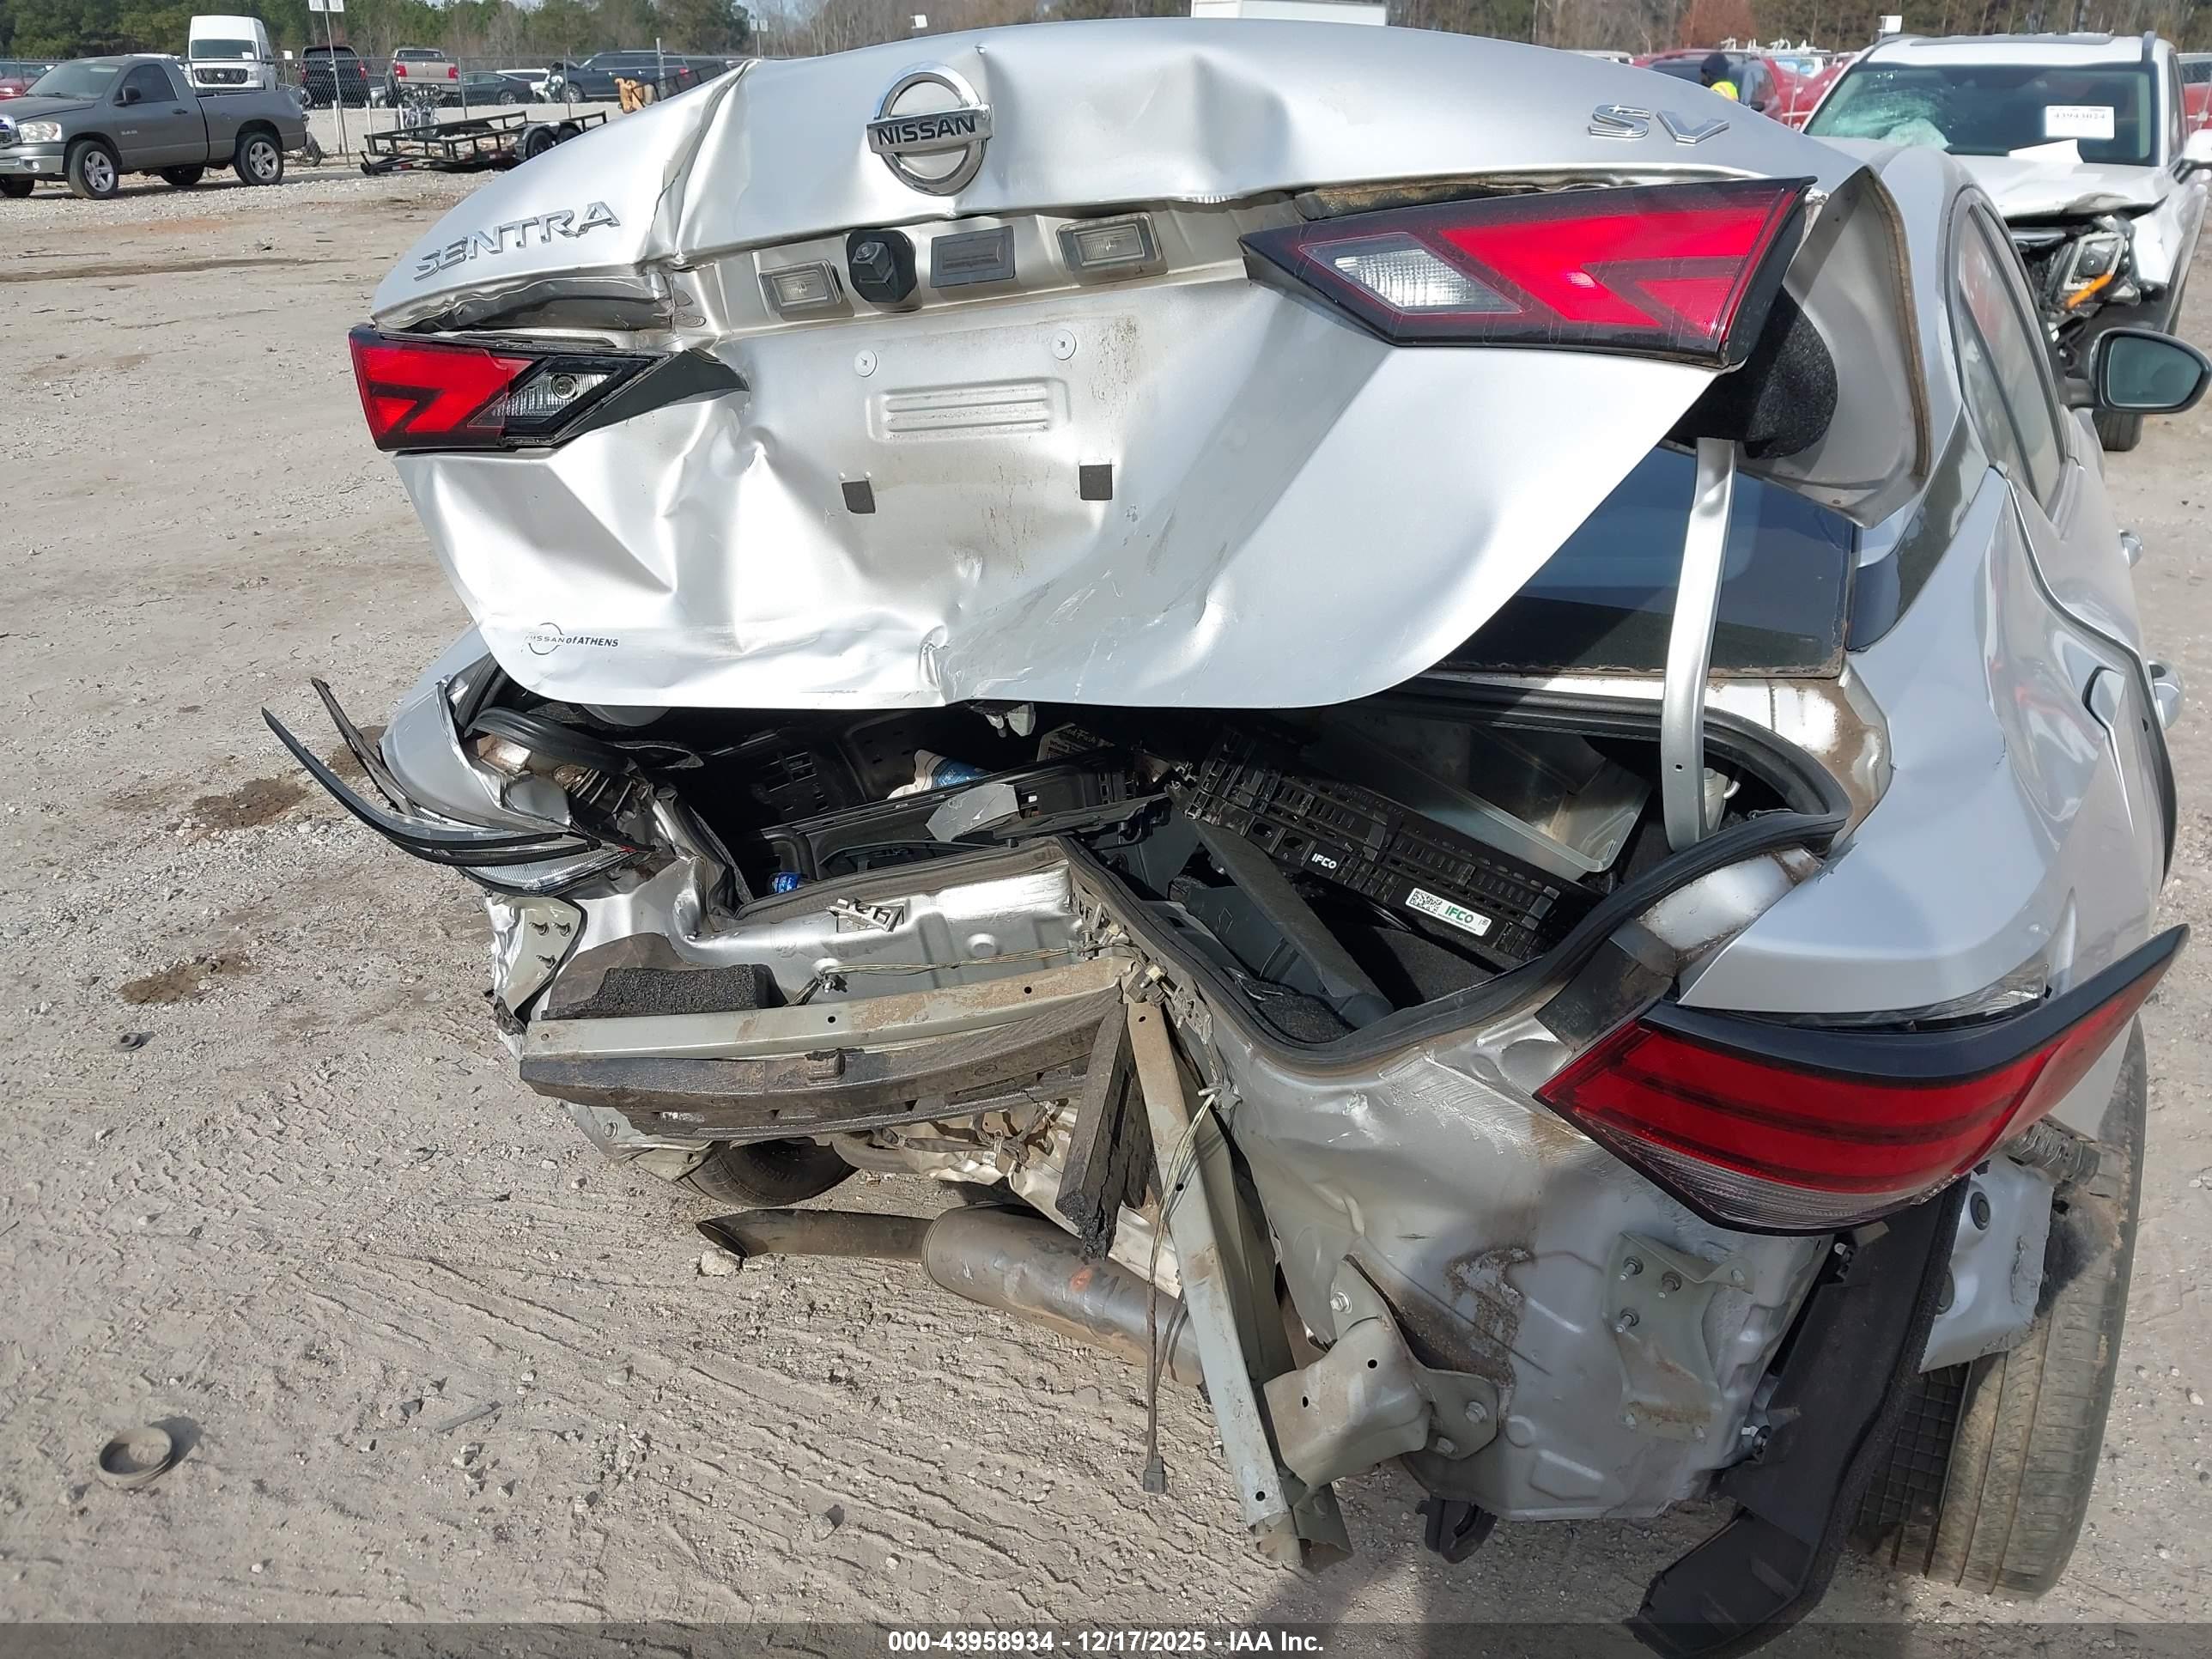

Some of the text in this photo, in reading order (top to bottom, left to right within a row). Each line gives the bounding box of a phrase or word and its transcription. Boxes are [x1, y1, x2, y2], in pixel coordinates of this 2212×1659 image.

[877, 115, 976, 146] NISSAN
[1588, 104, 1729, 146] SV
[413, 200, 621, 282] SENTRA
[1311, 853, 1337, 870] IFCO
[1444, 905, 1474, 924] IFCO
